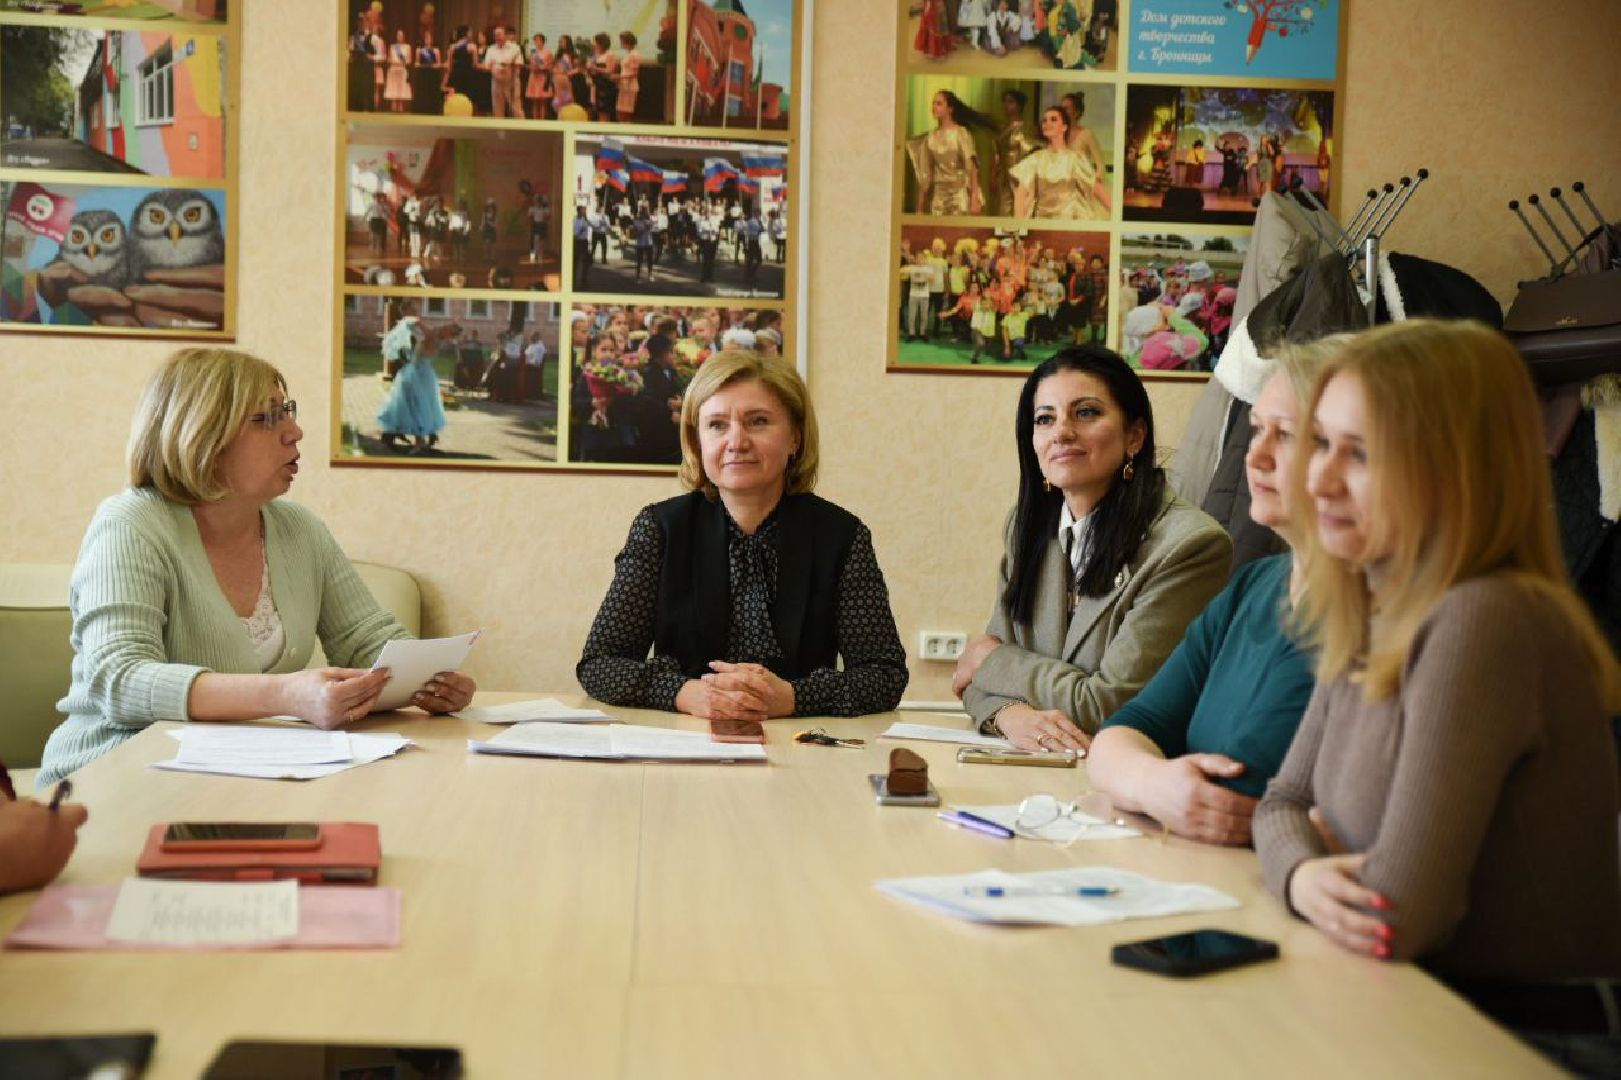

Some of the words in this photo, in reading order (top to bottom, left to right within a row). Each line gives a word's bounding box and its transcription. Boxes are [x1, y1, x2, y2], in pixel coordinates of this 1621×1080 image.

[1141, 9, 1167, 23] Дом
[1170, 14, 1226, 30] детского
[1138, 30, 1215, 47] творчества
